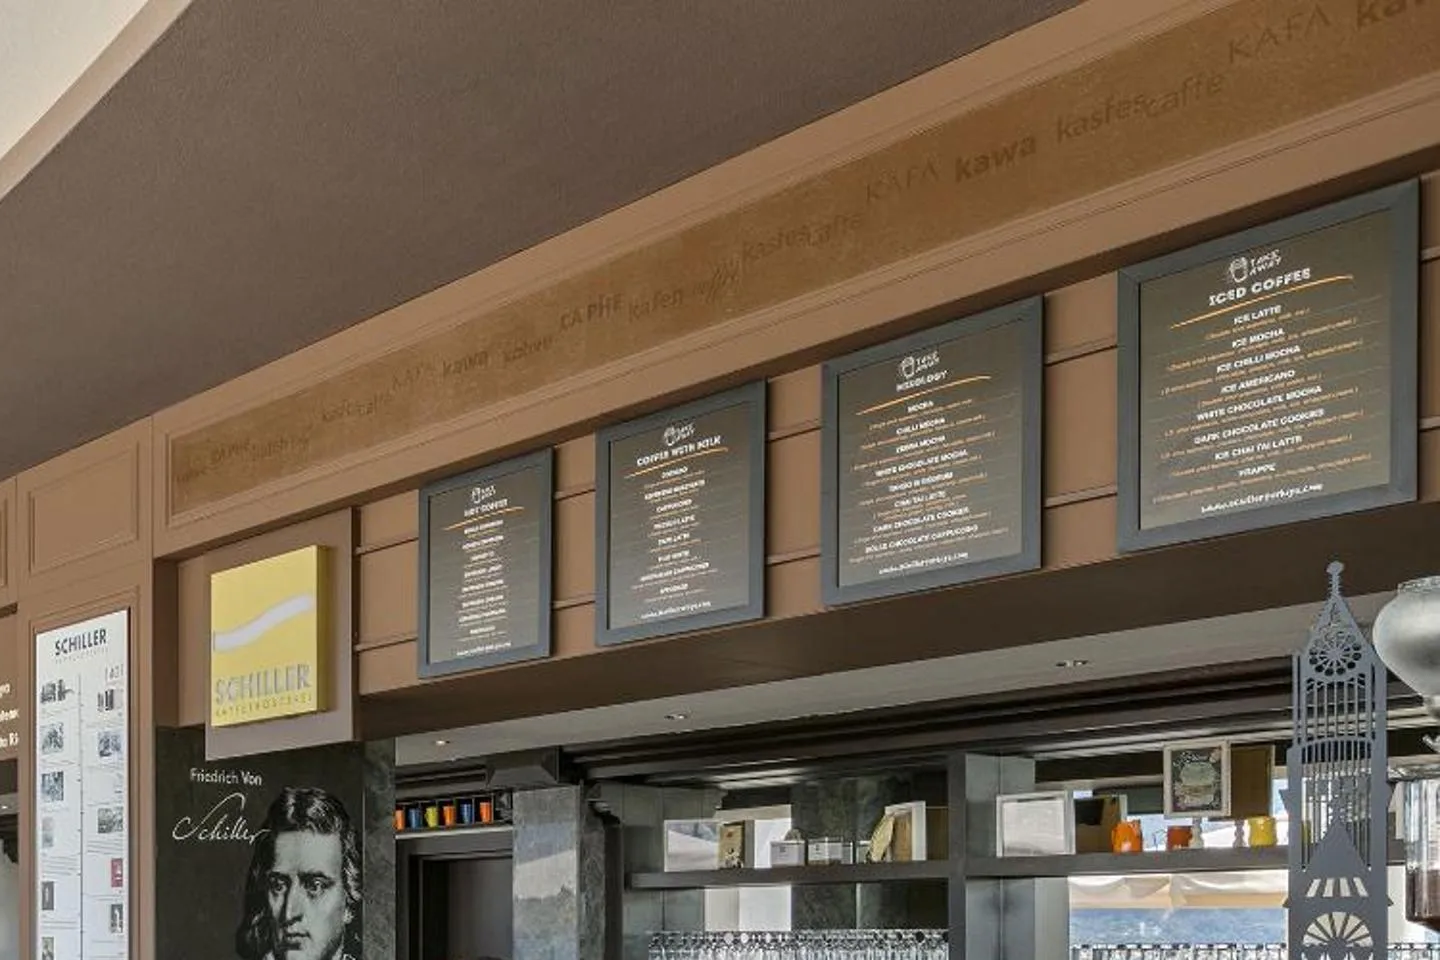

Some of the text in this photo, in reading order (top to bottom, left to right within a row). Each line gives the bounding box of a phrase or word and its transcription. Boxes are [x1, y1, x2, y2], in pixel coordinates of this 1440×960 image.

[1228, 2, 1331, 64] KAFA
[955, 135, 1037, 182] kawa
[1208, 286, 1247, 307] ICED
[1233, 313, 1250, 326] ICE
[1252, 304, 1282, 321] LATTE
[1232, 327, 1286, 349] ICE MOCHA
[1263, 344, 1302, 361] MOCHA
[1237, 369, 1297, 391] AMERICANO
[1196, 408, 1226, 422] WHITE
[1227, 395, 1285, 416] CHOCOLATE
[1286, 385, 1323, 401] MOCHA
[1222, 418, 1279, 439] CHOCOLATE
[1272, 434, 1303, 450] LATTE
[55, 628, 107, 656] SCHILLER
[215, 662, 313, 705] SCHILLER
[189, 767, 263, 787] Friedrich Von
[171, 792, 273, 845] Schiller
